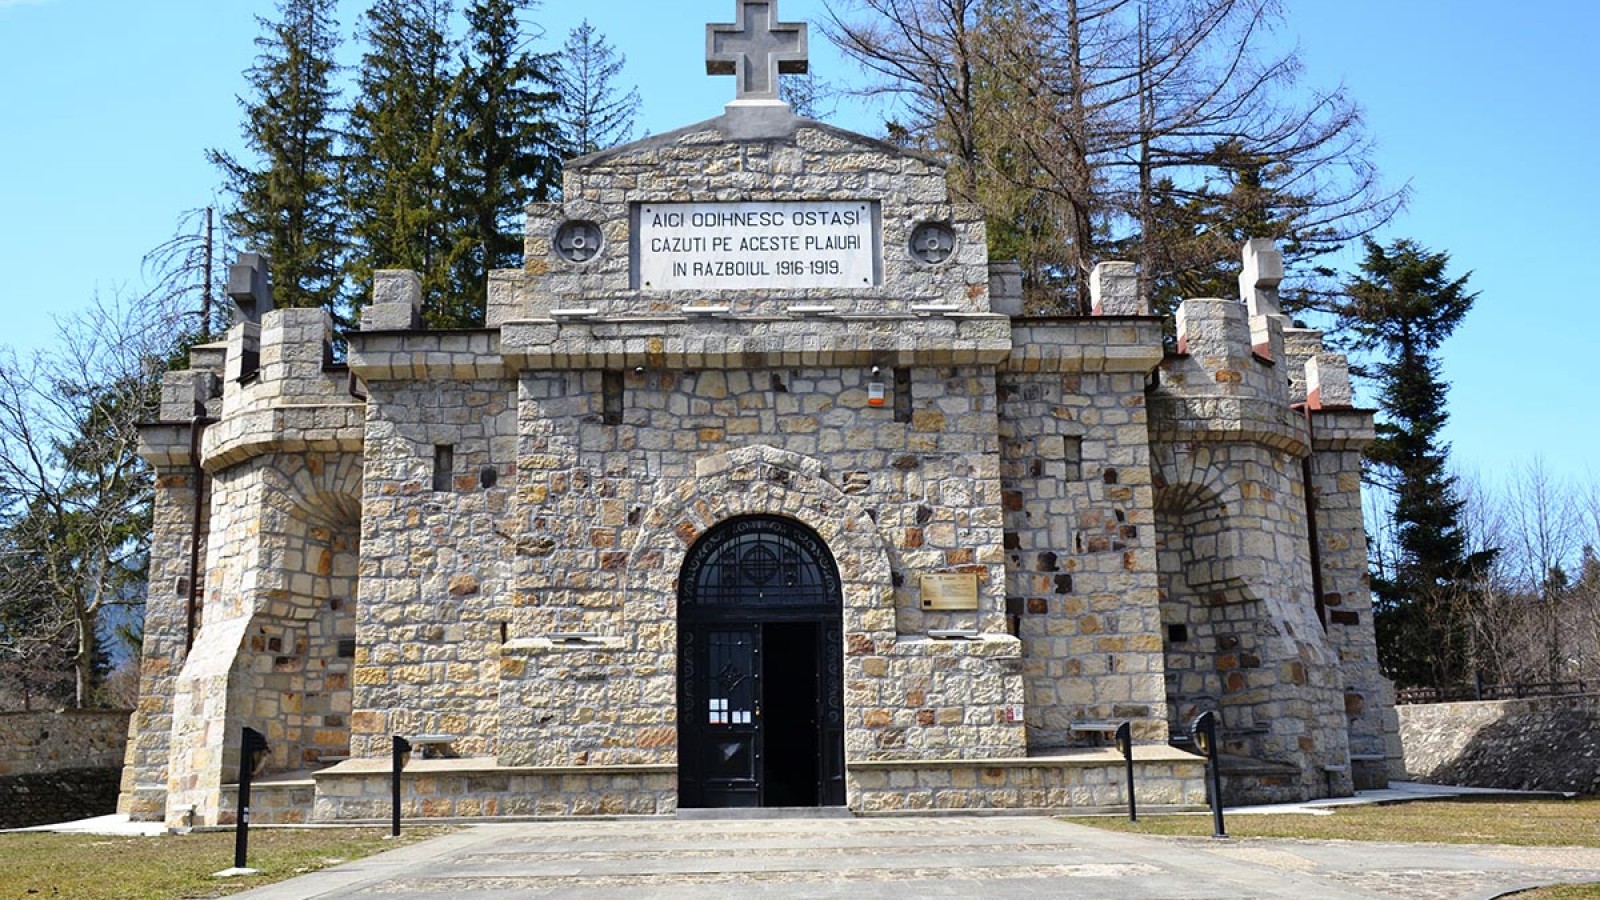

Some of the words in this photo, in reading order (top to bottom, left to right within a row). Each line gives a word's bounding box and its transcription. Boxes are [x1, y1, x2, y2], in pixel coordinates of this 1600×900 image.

[651, 211, 684, 228] AICI
[691, 211, 786, 228] ODIHNESC
[651, 236, 706, 253] CAZUTI
[712, 236, 733, 252] PE
[739, 235, 800, 252] ACESTE
[804, 234, 861, 251] PLAIURI
[672, 261, 687, 277] IN
[692, 260, 770, 277] RAZBOIUL
[776, 259, 843, 276] 1916-1919.
